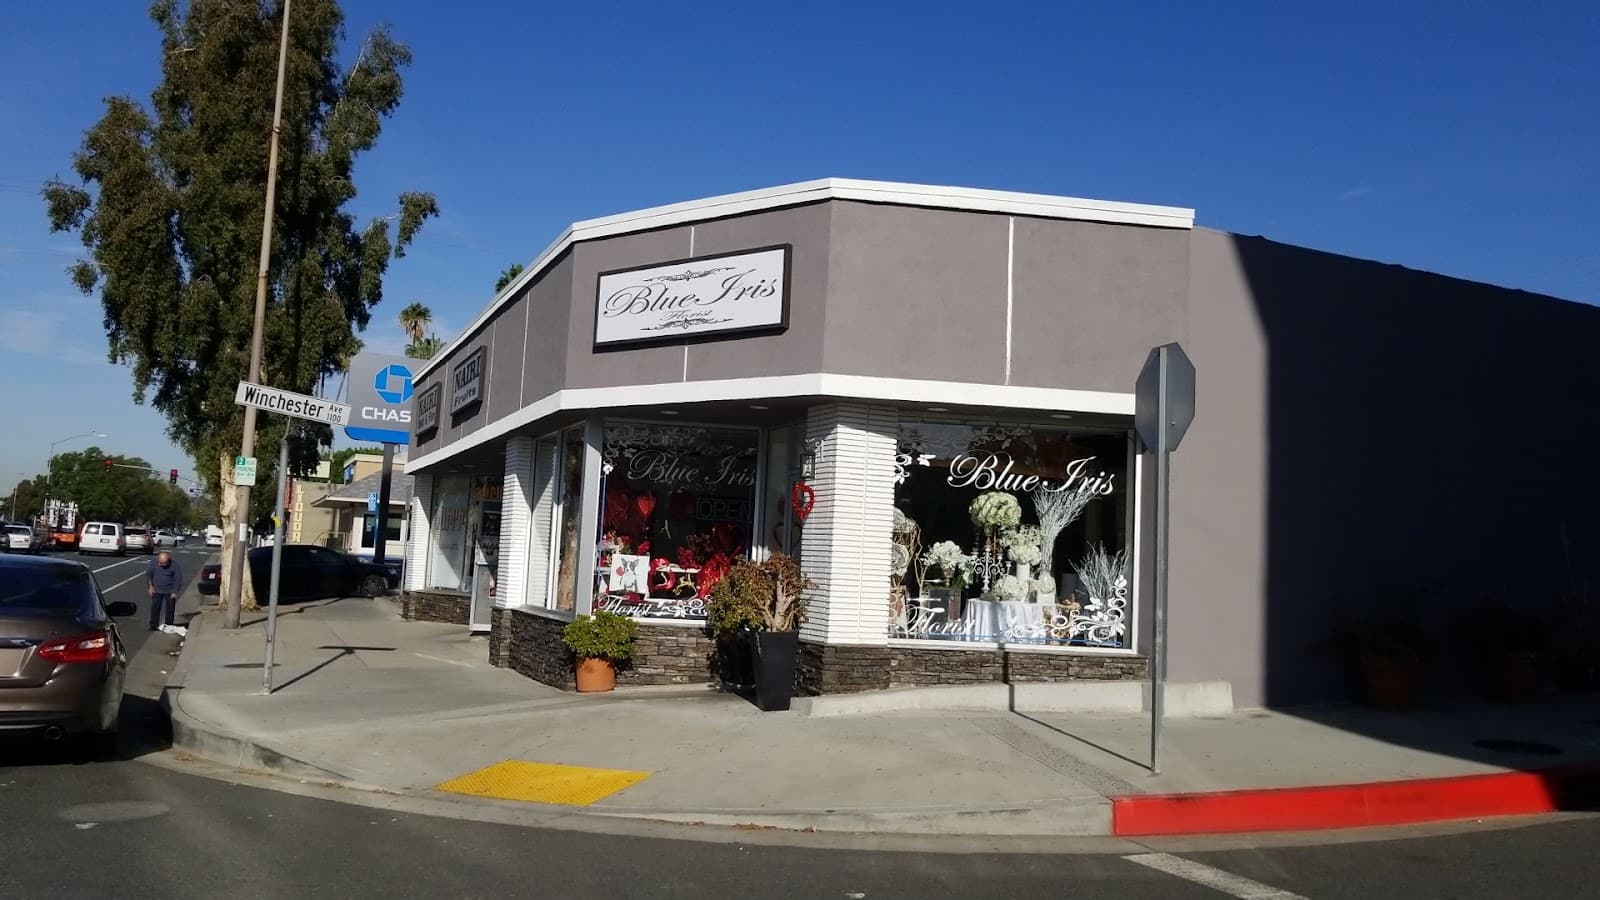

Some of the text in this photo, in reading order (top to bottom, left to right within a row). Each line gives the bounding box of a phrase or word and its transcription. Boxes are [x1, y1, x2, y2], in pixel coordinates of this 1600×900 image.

[602, 268, 777, 318] Blue Iris
[659, 309, 713, 321] Florist
[454, 355, 481, 392] NAIRI
[244, 386, 343, 417] Winchester Ave
[361, 406, 412, 423] CHAS
[326, 413, 342, 424] 1100
[627, 449, 757, 487] Blue Iris
[947, 449, 1116, 495] Blue Iris
[699, 499, 752, 520] OPEN
[896, 605, 976, 636] Florist
